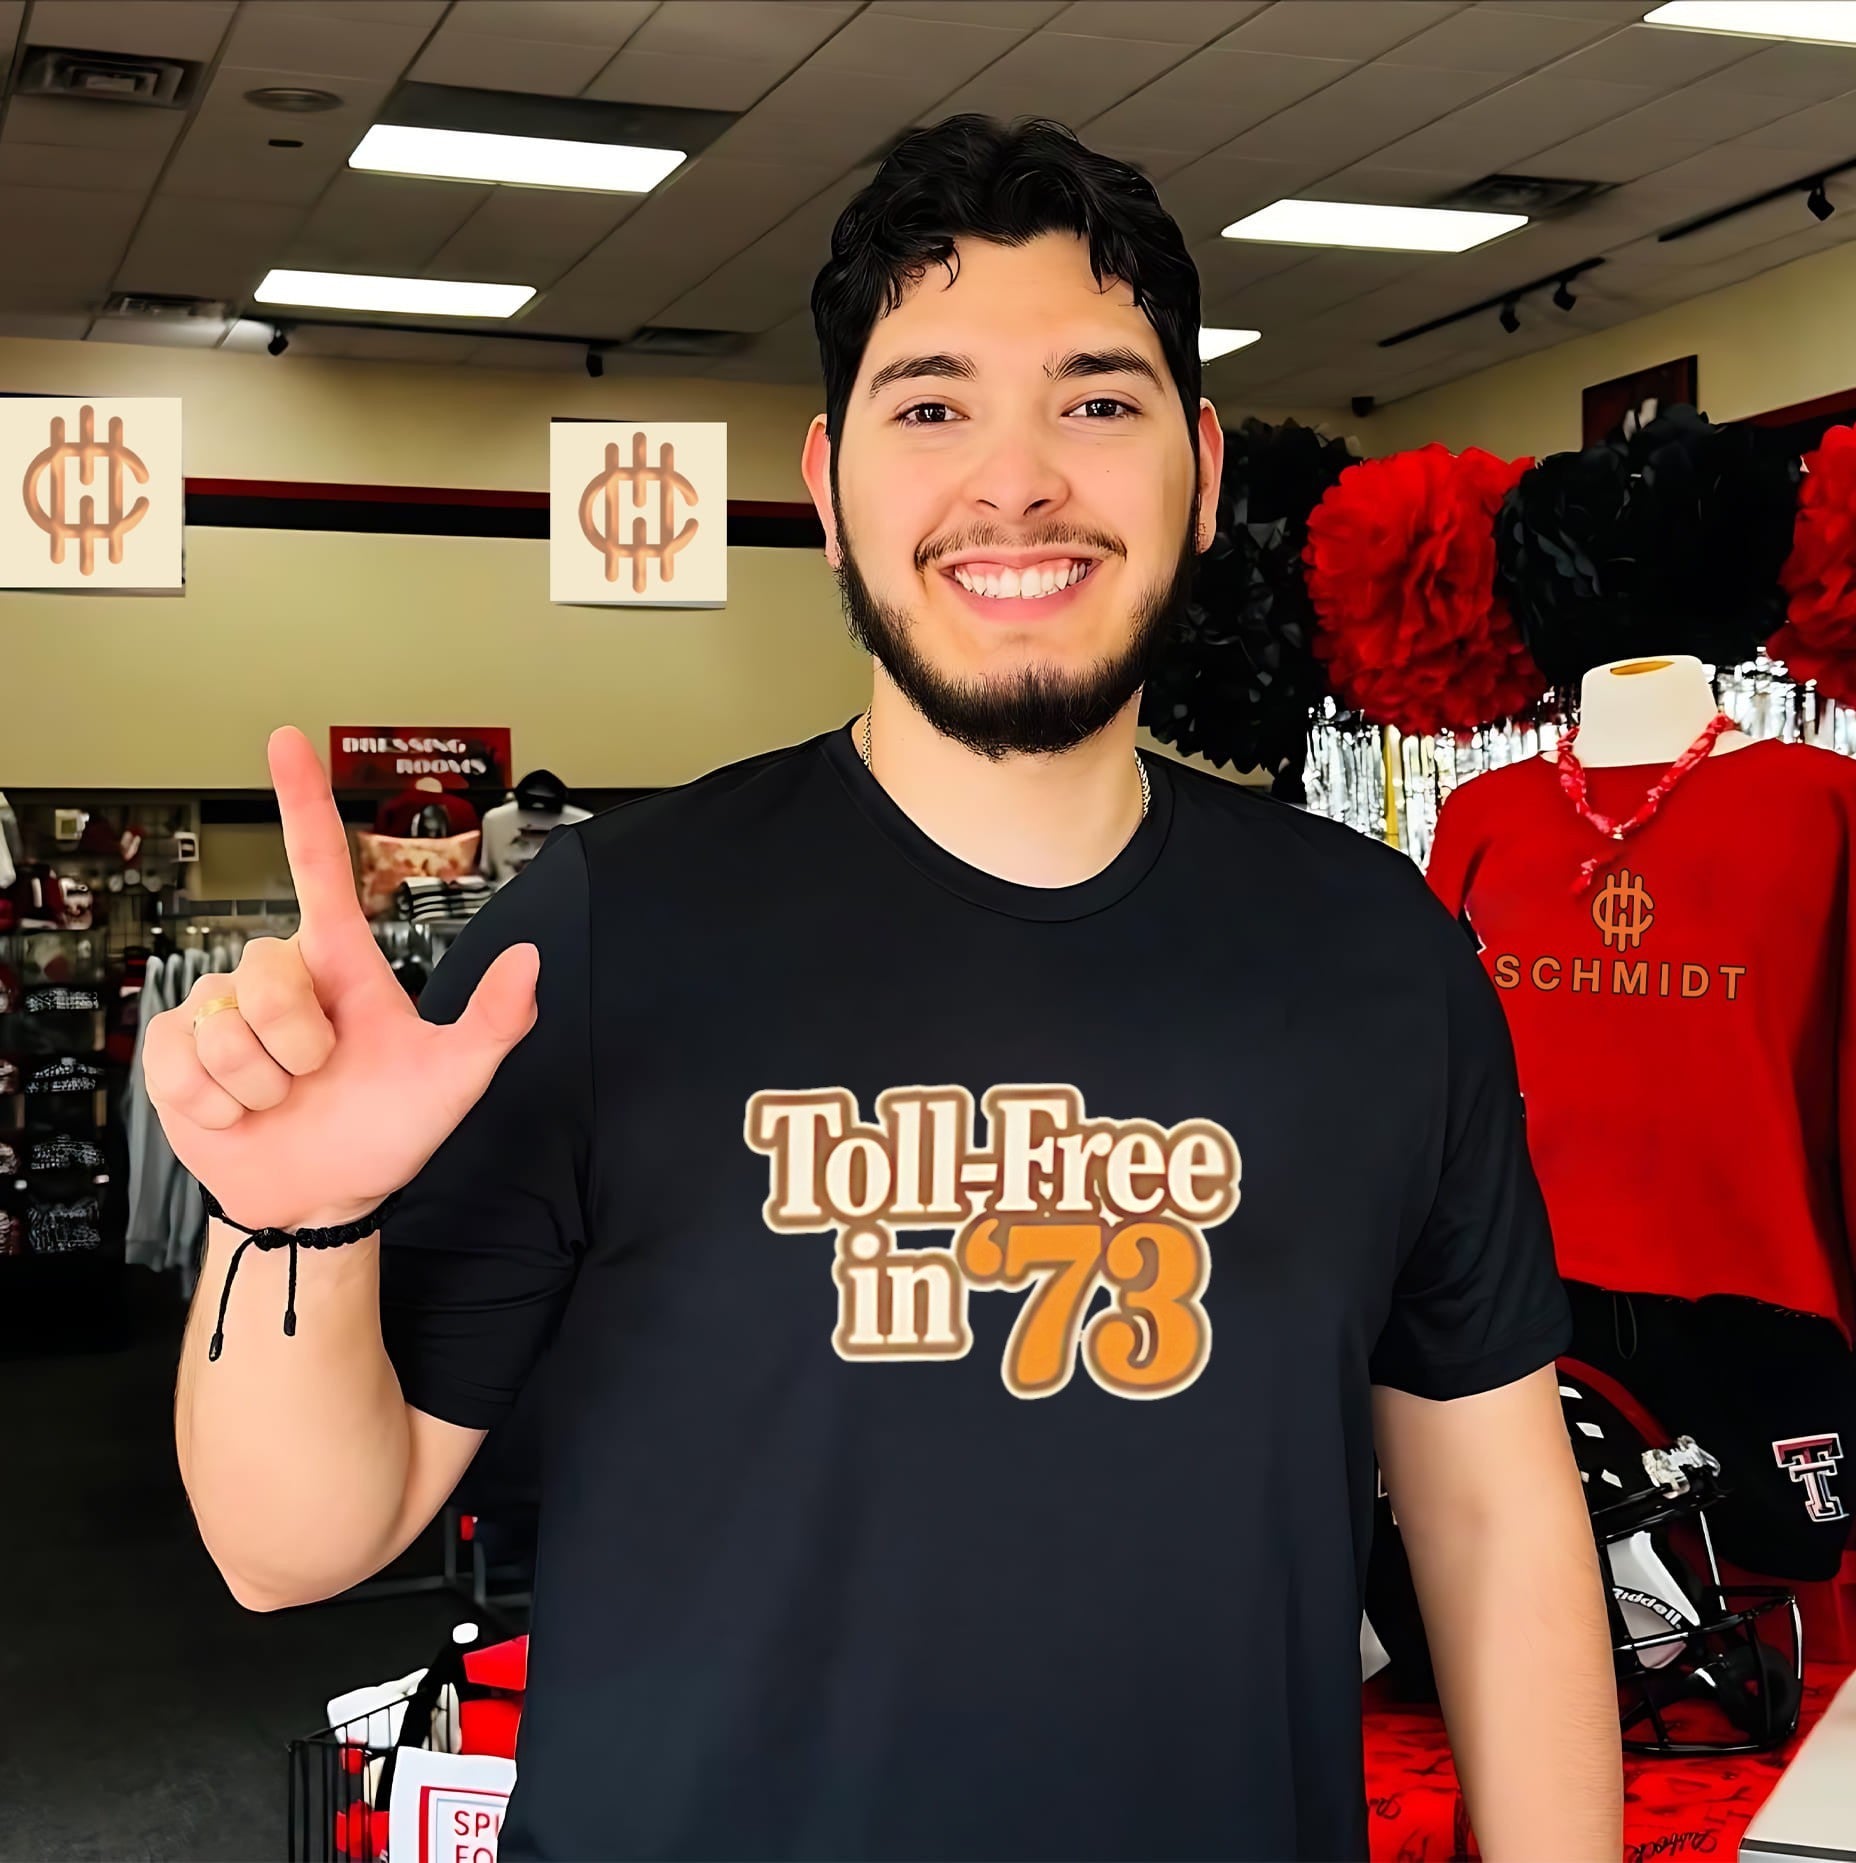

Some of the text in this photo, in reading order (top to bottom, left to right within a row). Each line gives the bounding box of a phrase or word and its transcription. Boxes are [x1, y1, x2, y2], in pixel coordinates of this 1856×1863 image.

[342, 737, 467, 754] DRESSING
[396, 758, 487, 775] ROOMS
[1494, 953, 1747, 1000] SCHMIDT
[749, 1088, 1236, 1227] Toll-Free
[838, 1226, 966, 1353] in
